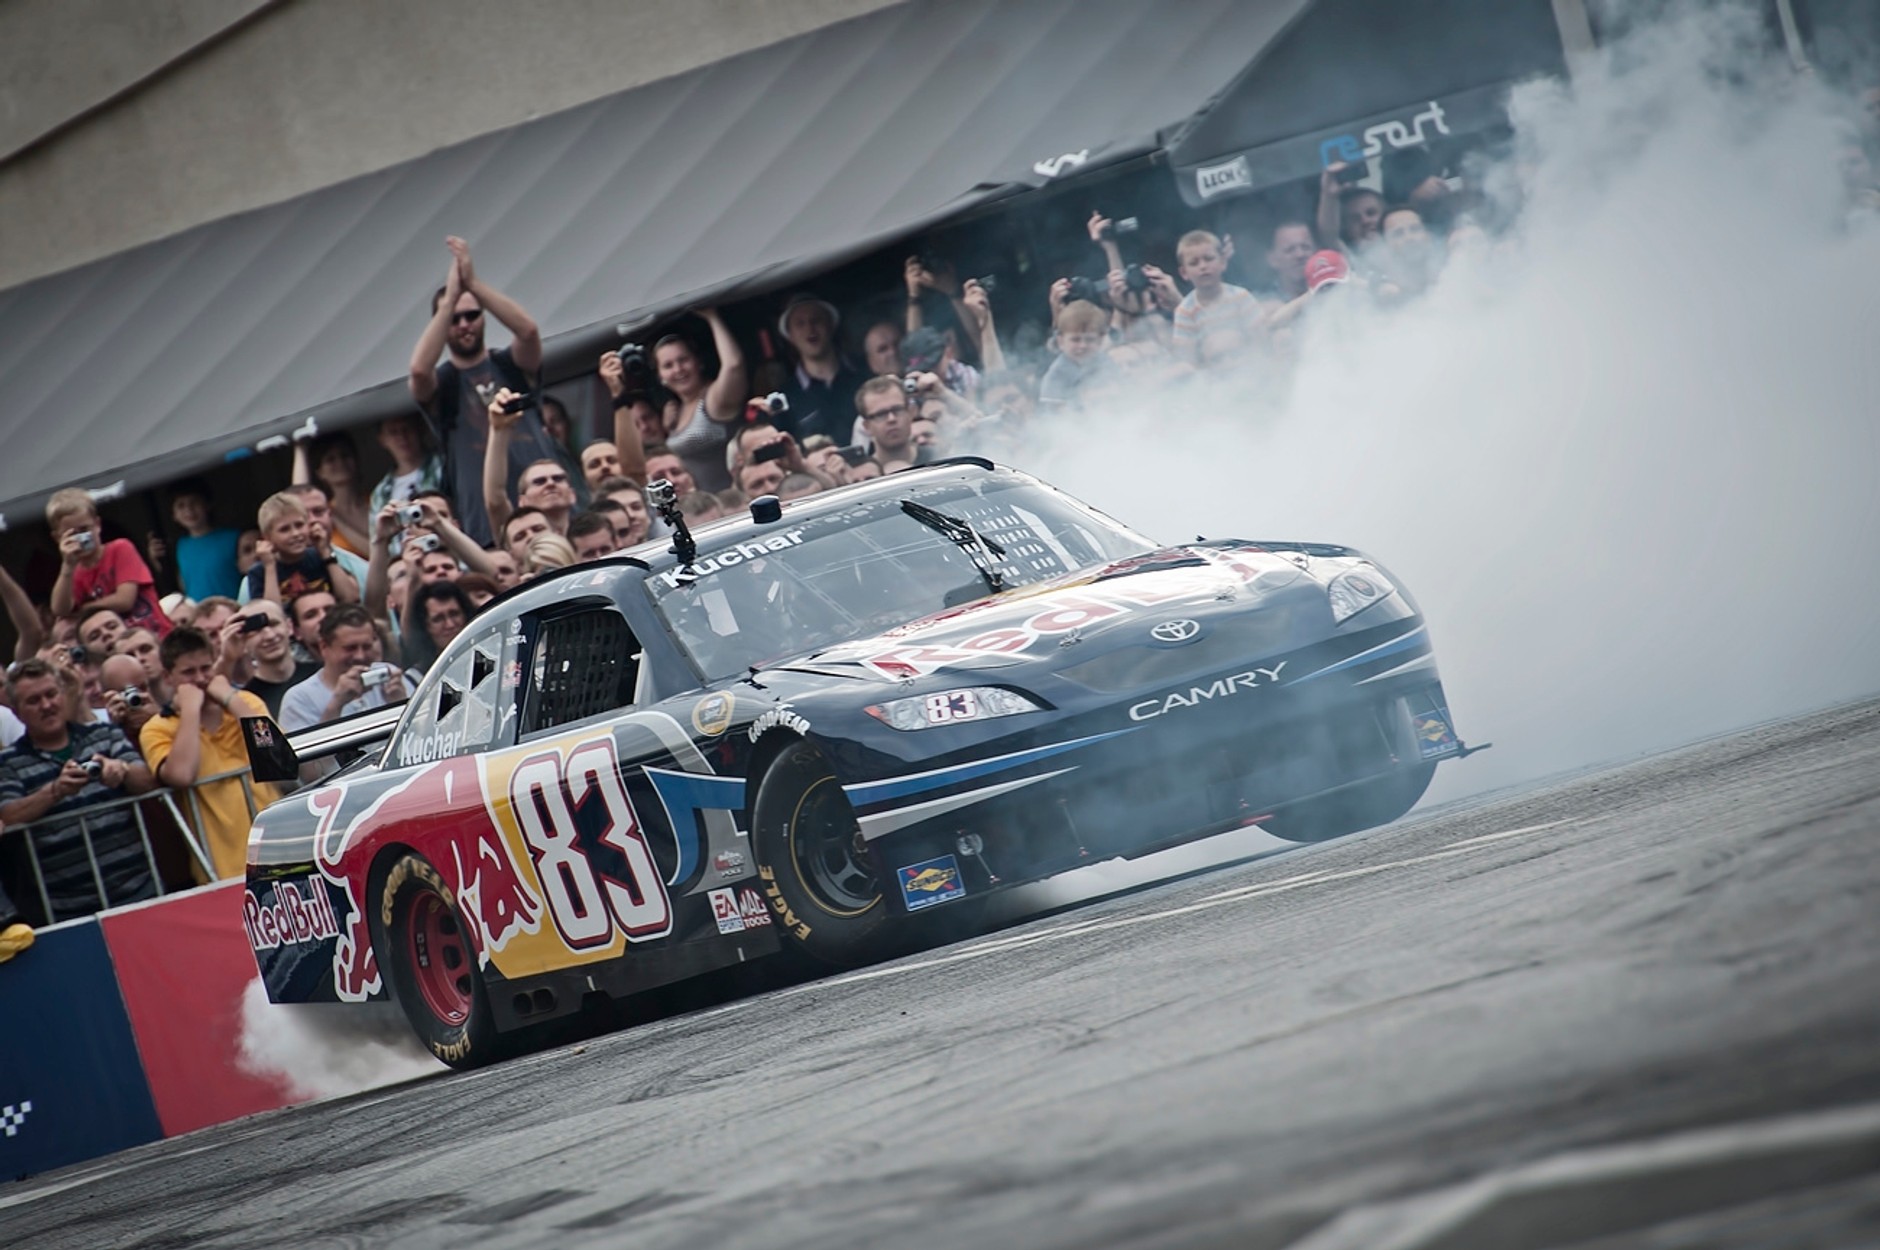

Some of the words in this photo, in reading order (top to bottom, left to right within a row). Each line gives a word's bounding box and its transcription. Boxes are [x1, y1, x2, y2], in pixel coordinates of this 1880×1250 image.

[1319, 101, 1449, 169] resort
[660, 530, 804, 588] Kuchar
[864, 598, 1130, 680] Red
[926, 690, 977, 723] 83
[1129, 661, 1288, 721] CAMRY
[400, 728, 462, 766] Kuchar
[508, 734, 673, 955] 83
[715, 894, 739, 919] EA
[744, 914, 772, 928] TOOLS
[759, 865, 812, 940] EAGLE
[433, 1031, 472, 1061] EAGLE
